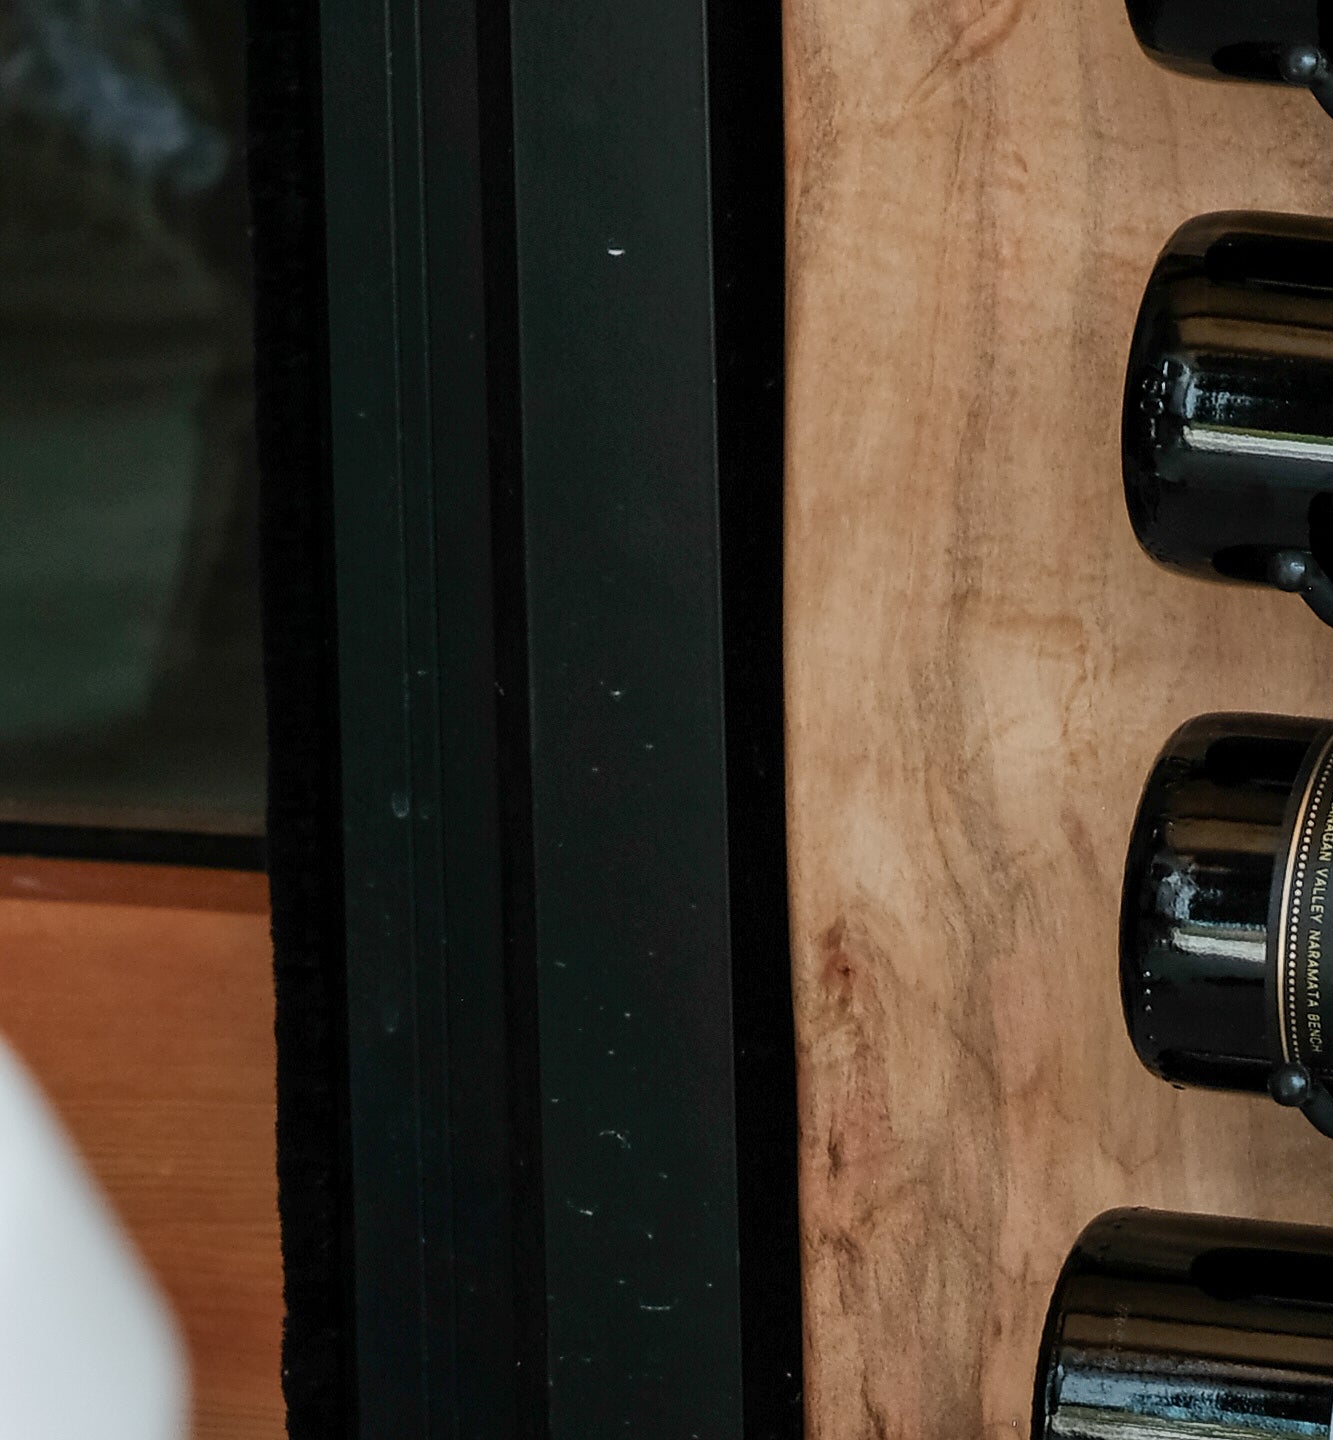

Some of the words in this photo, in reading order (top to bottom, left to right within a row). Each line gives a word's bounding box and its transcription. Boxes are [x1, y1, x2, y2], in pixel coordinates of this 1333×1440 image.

[1309, 868, 1330, 923] VALLEY
[1306, 930, 1321, 1007] NARAMATA
[1306, 1013, 1323, 1053] BENCH
